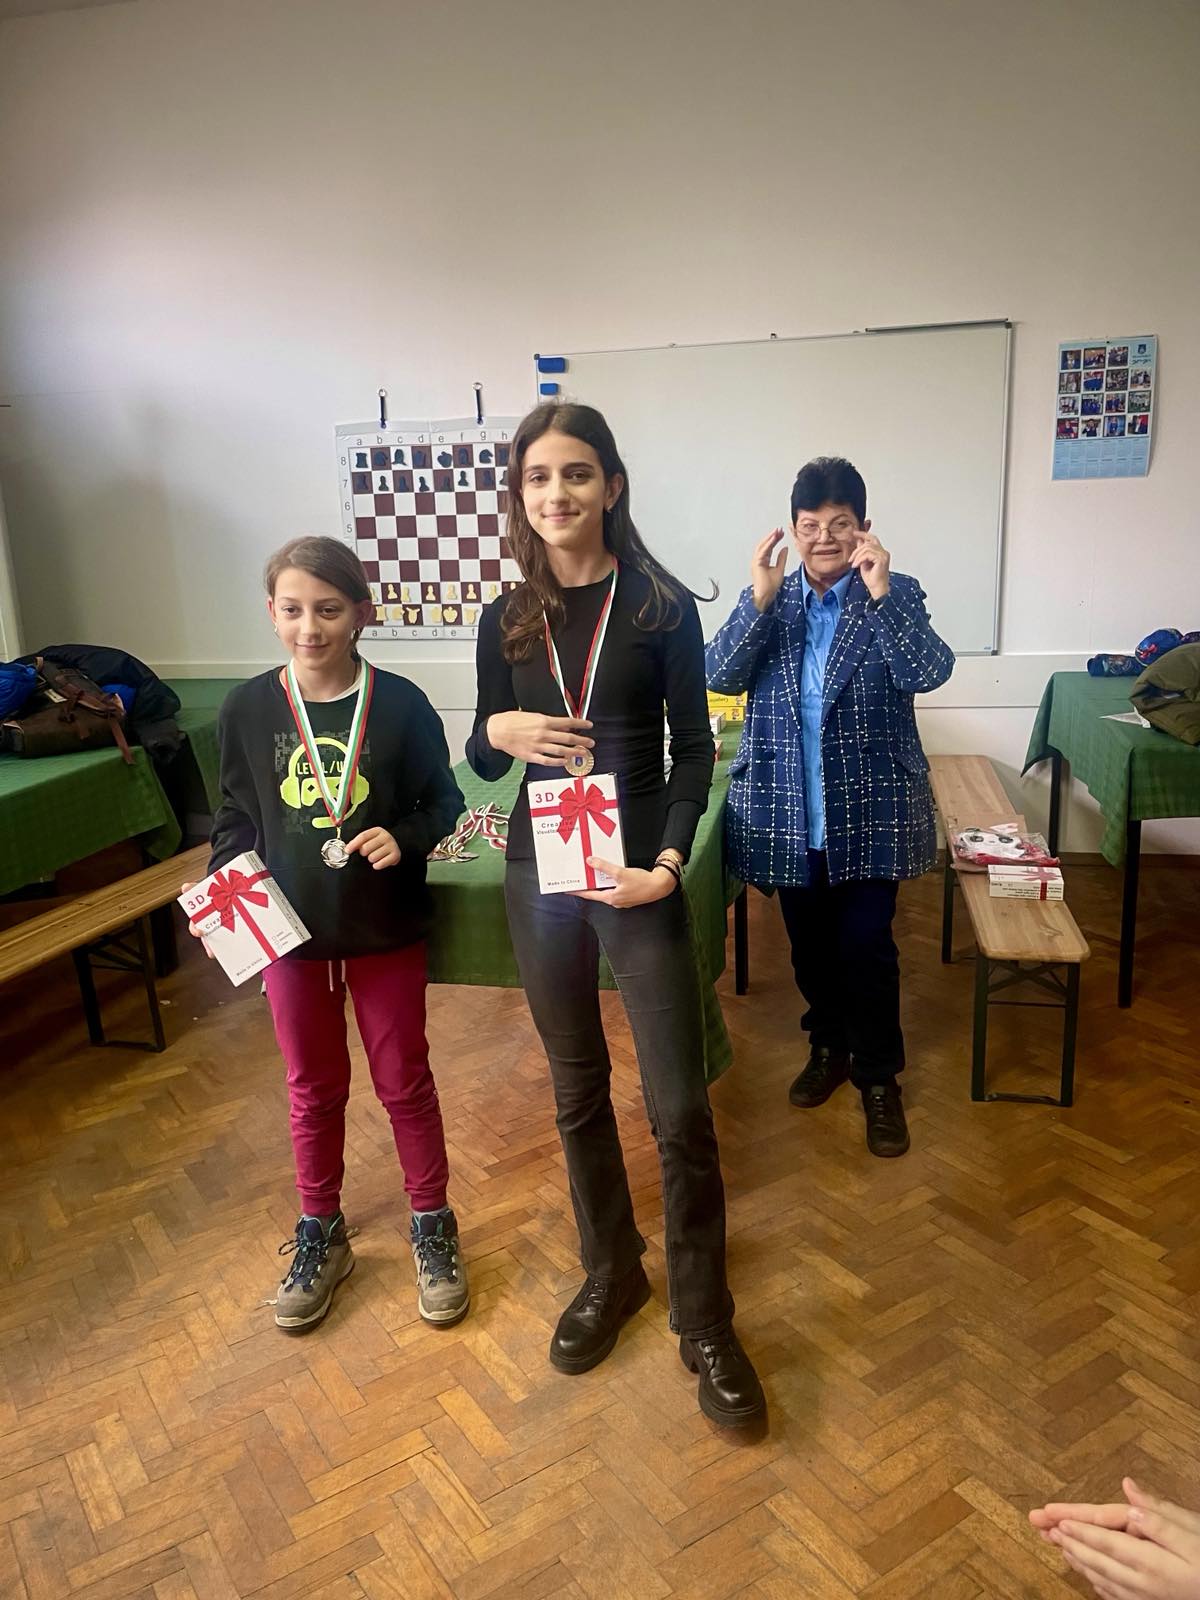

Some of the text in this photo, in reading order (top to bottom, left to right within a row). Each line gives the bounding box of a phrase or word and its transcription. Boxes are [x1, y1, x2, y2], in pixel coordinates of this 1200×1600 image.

[376, 436, 383, 444] b
[418, 435, 424, 443] d
[438, 435, 445, 443] e
[480, 431, 487, 441] g
[501, 432, 508, 440] h
[340, 456, 347, 466] 8
[342, 480, 348, 488] 7
[344, 502, 351, 511] 6
[346, 524, 353, 533] 5
[391, 628, 398, 637] b
[432, 628, 438, 637] d
